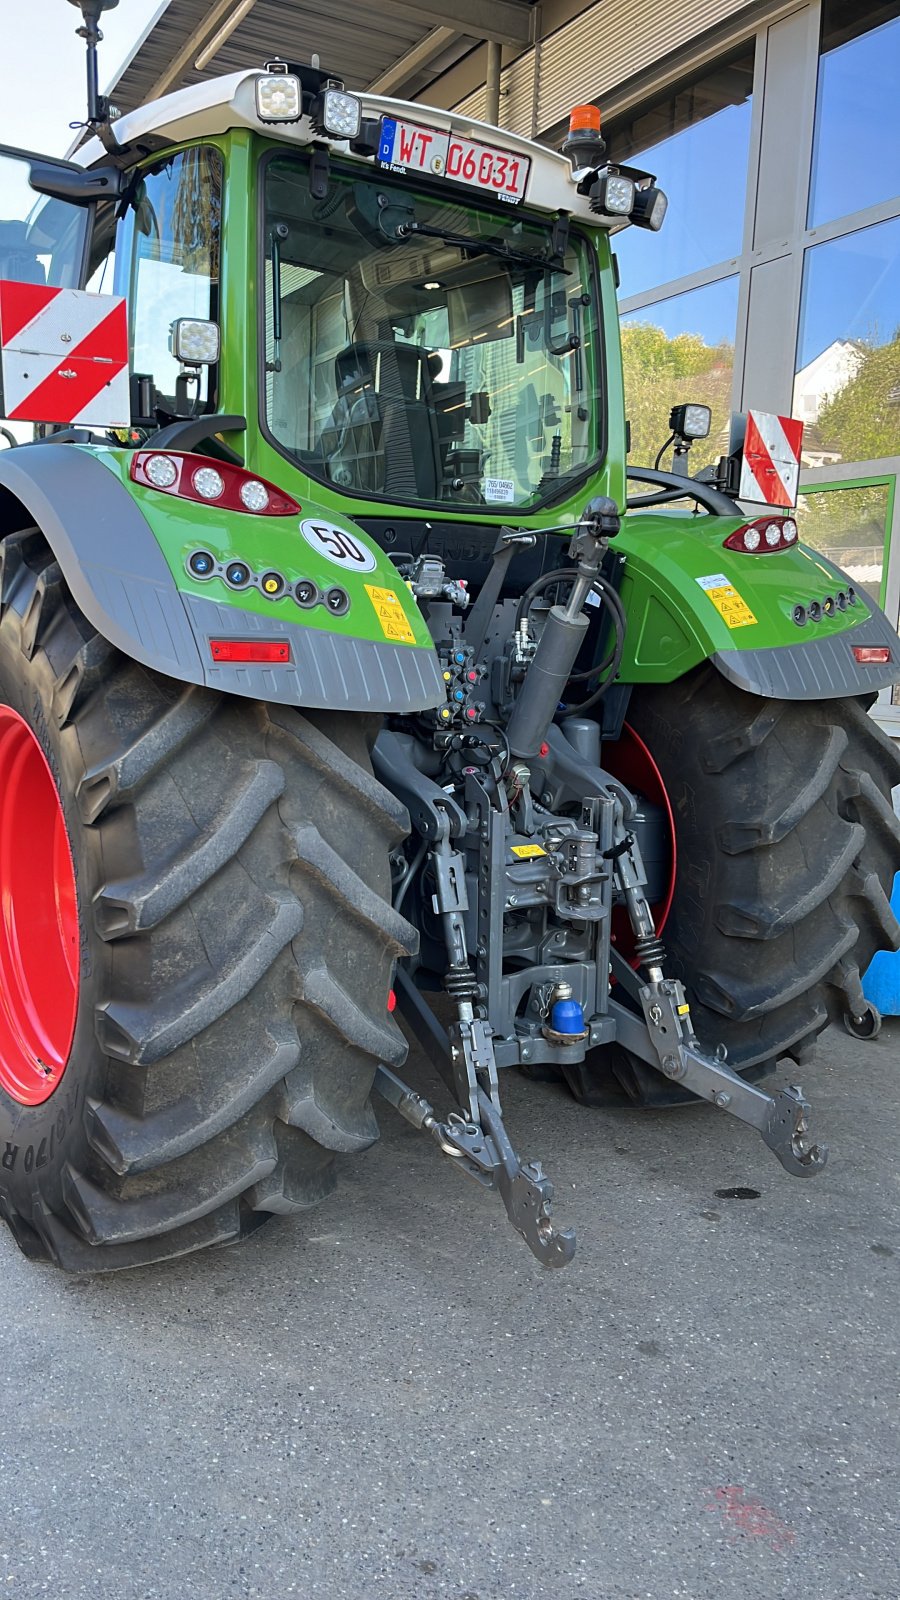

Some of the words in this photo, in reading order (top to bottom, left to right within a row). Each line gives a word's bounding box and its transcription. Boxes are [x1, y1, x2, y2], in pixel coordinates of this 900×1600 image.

[383, 144, 390, 154] D
[399, 128, 433, 167] WT
[446, 143, 520, 193] 06031
[497, 192, 521, 205] FENDT
[310, 525, 366, 563] 50
